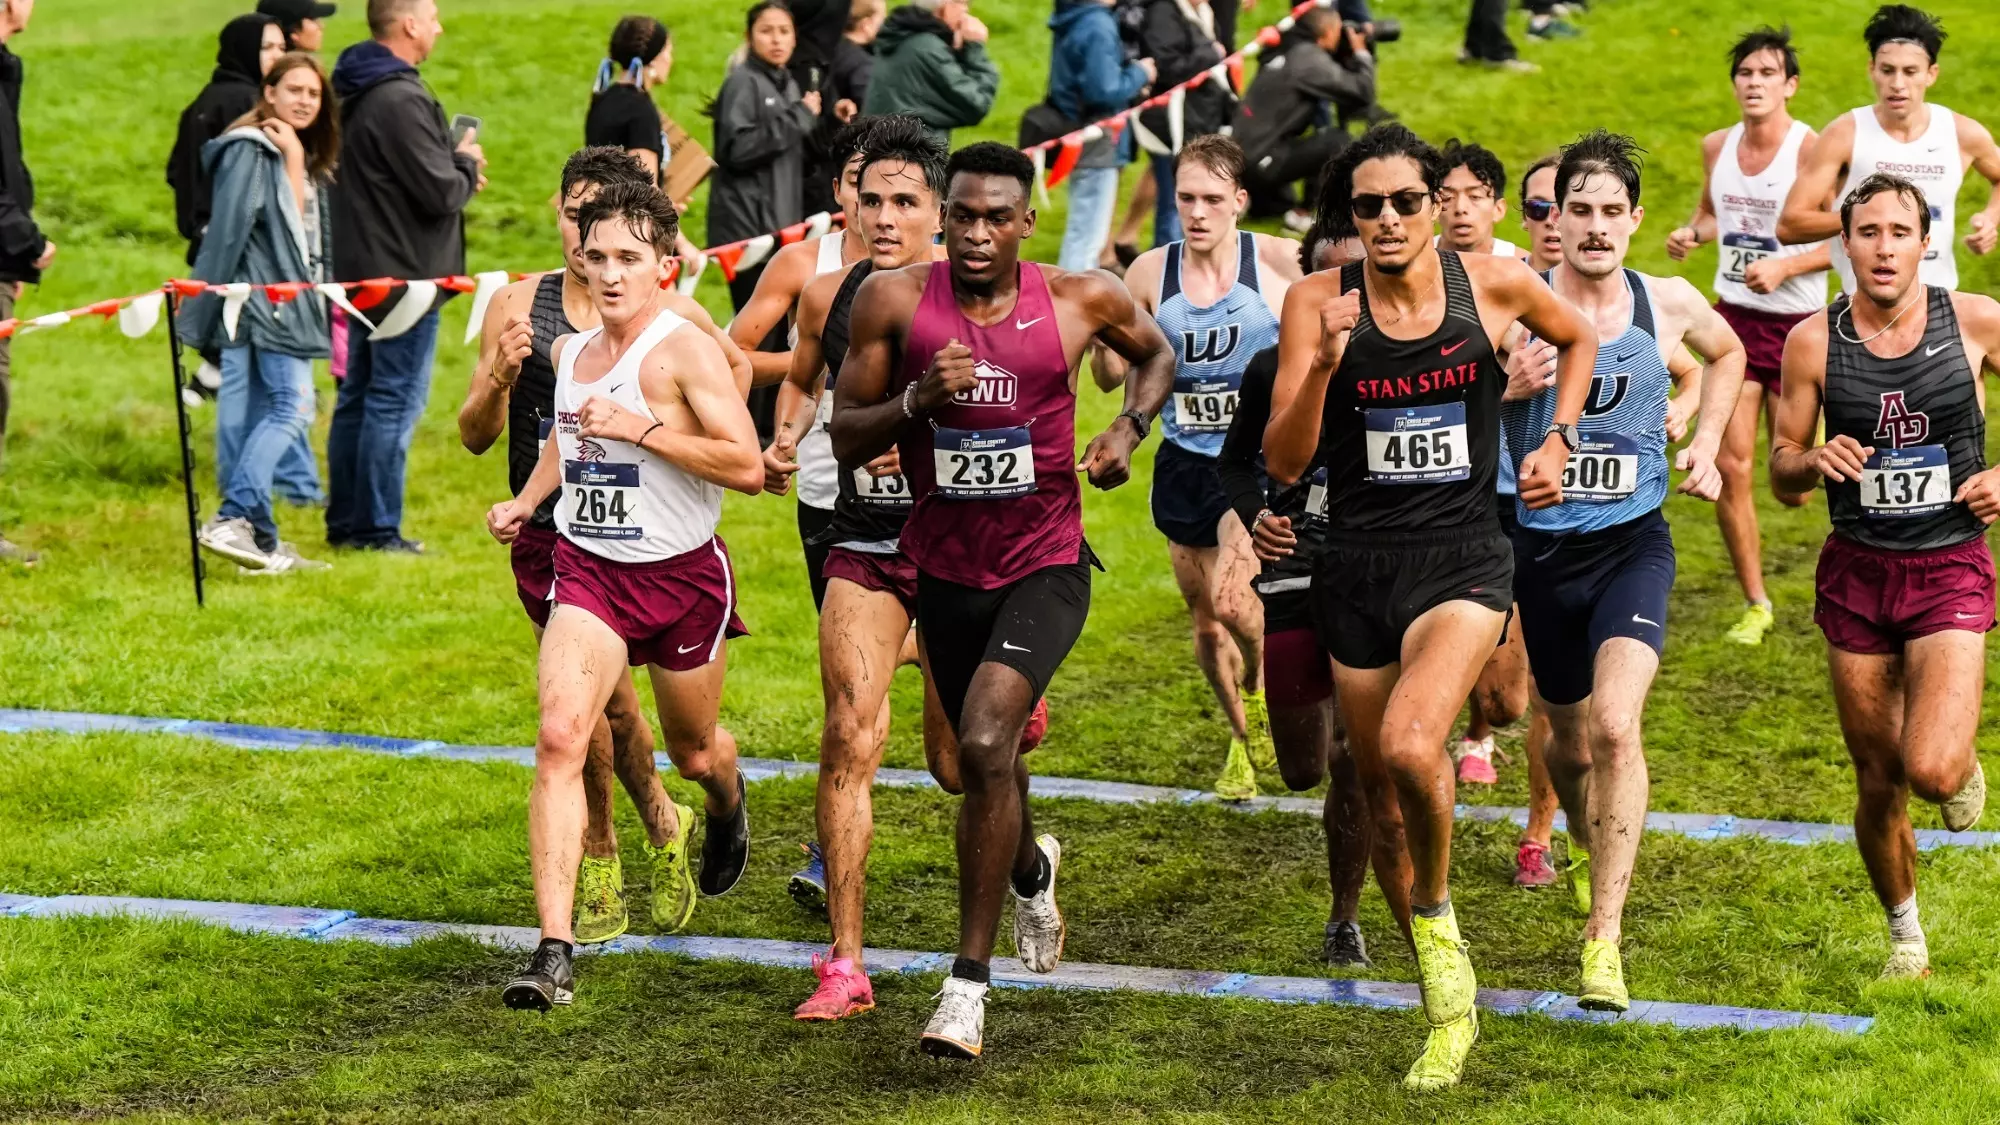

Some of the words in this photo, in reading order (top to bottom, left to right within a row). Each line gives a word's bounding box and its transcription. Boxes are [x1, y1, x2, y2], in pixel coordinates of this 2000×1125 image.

[1914, 165, 1945, 174] STATE
[1731, 249, 1767, 272] 26
[1180, 323, 1241, 365] W
[1357, 376, 1412, 399] STAN
[1418, 362, 1477, 393] STATE
[1383, 430, 1452, 469] 465
[950, 452, 1019, 485] 232
[1875, 470, 1932, 505] 137
[575, 488, 625, 524] 264
